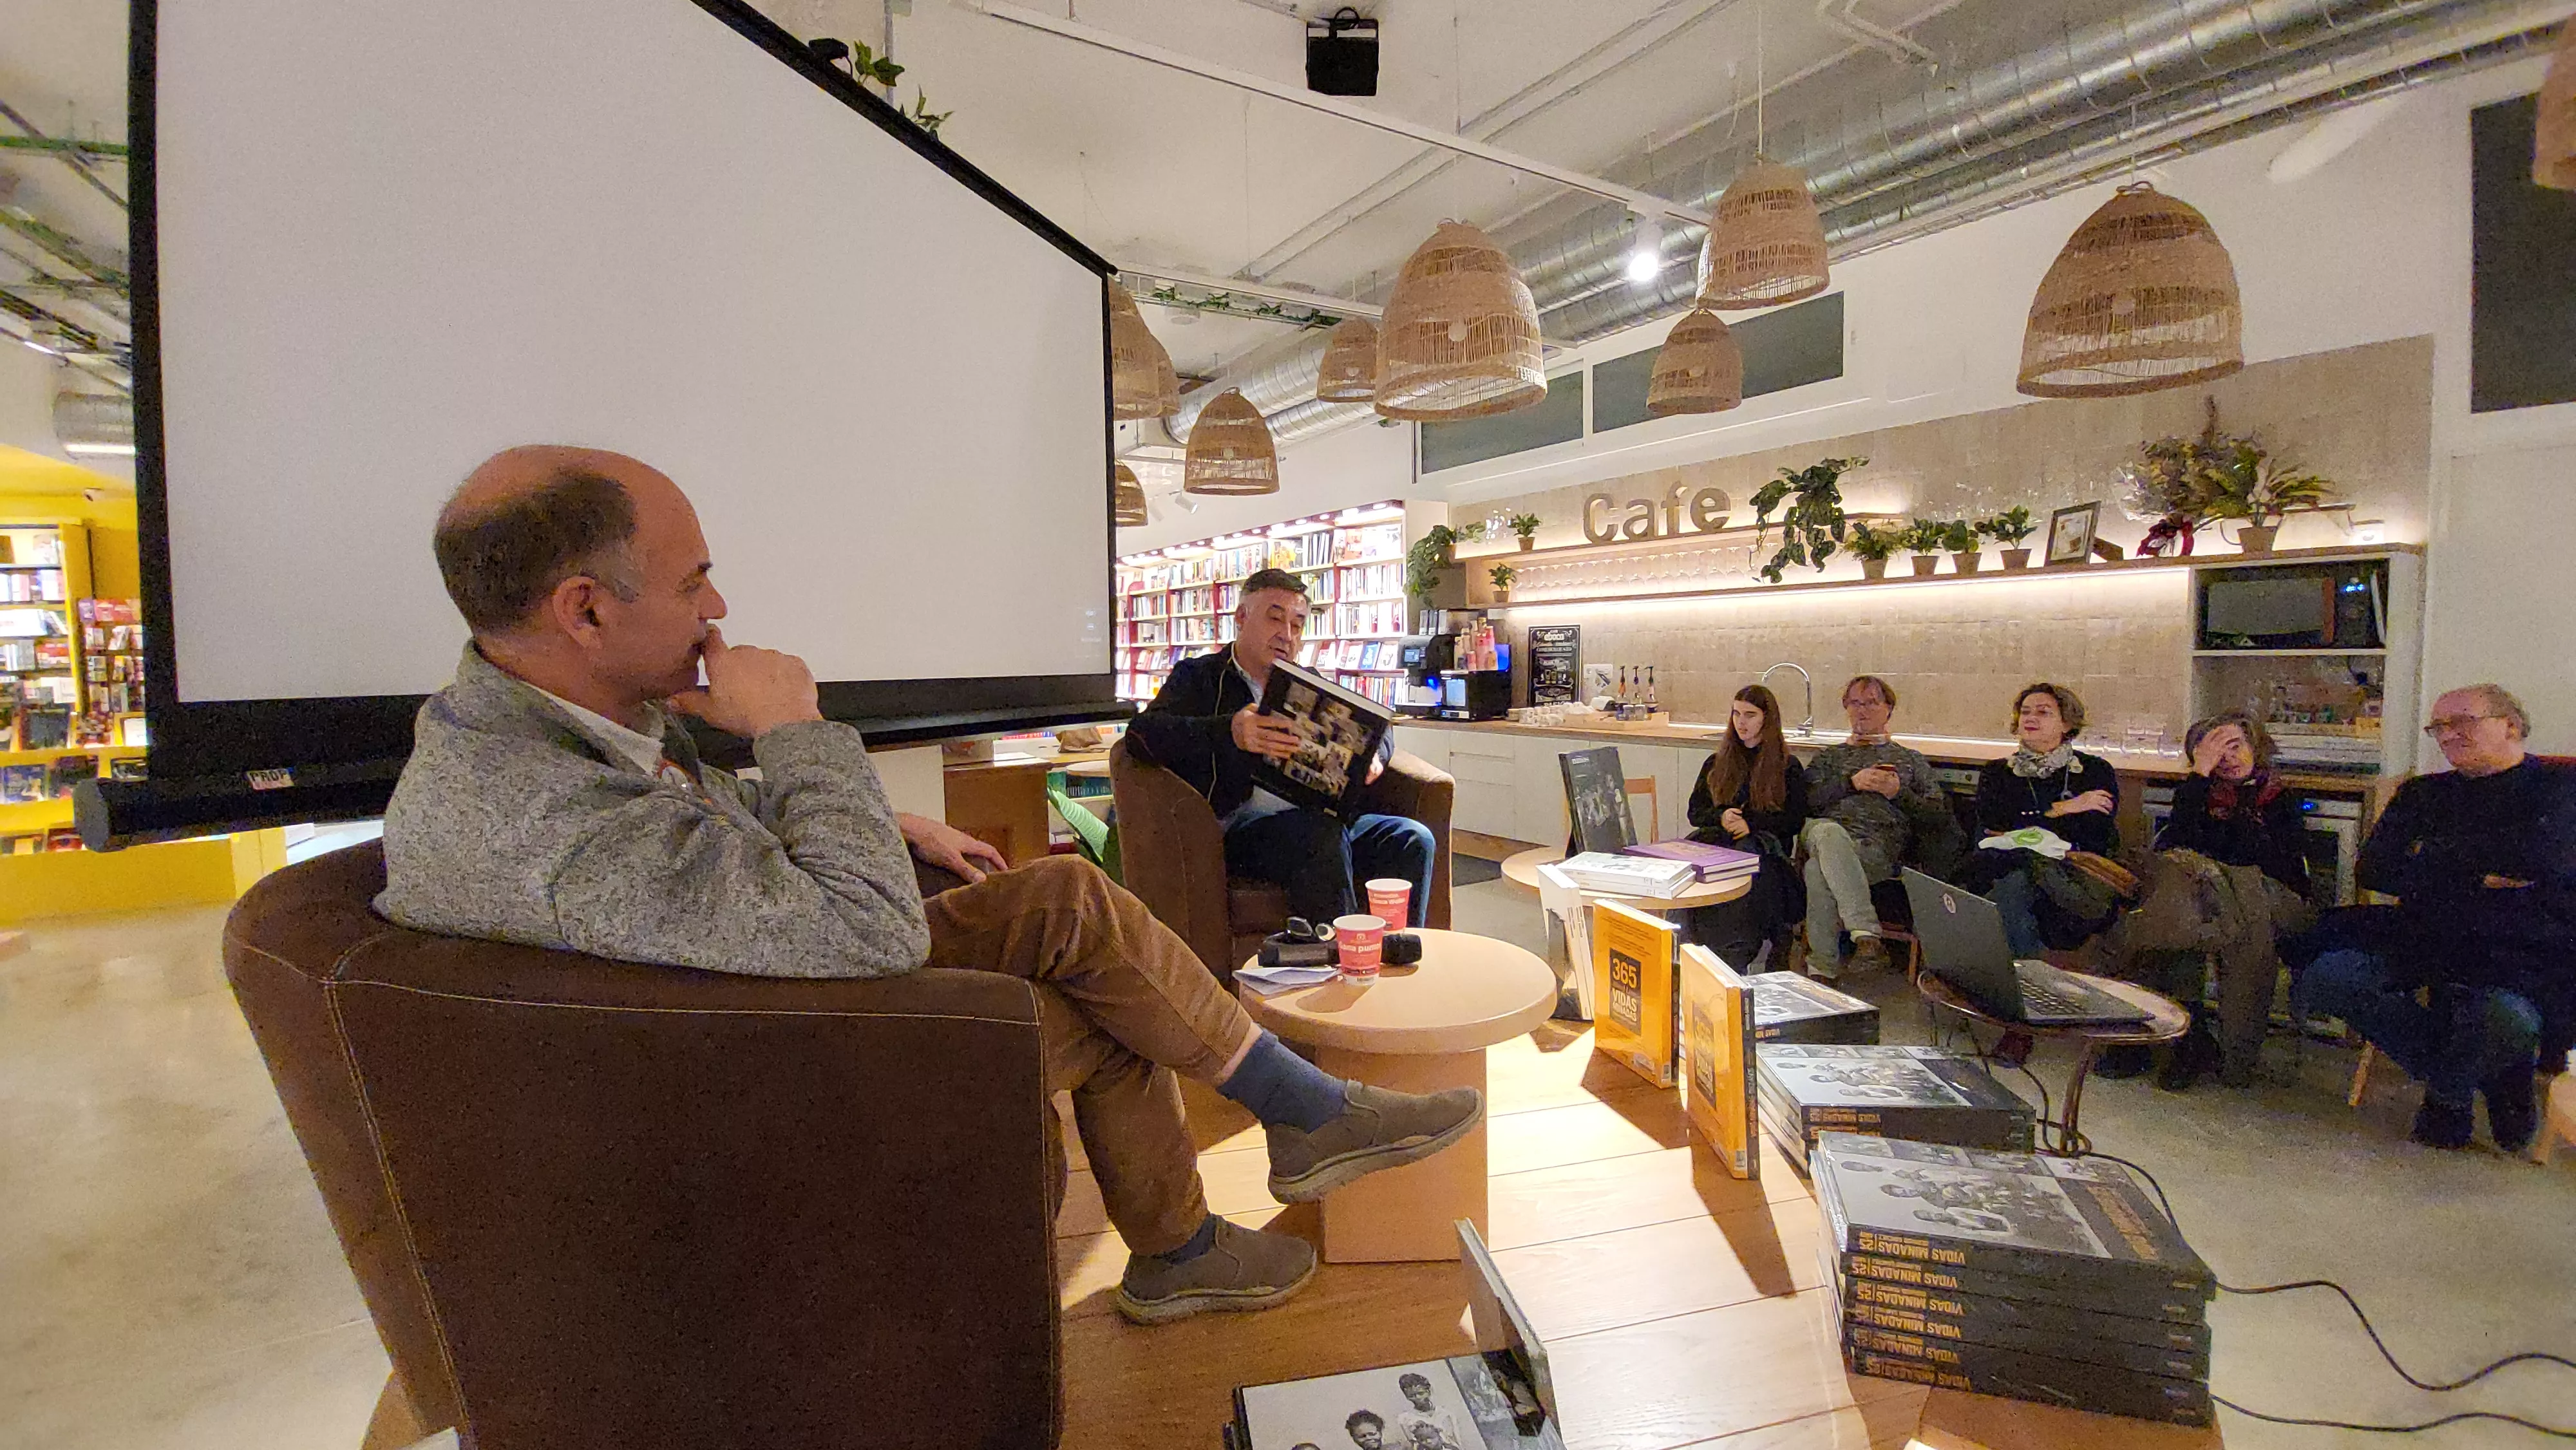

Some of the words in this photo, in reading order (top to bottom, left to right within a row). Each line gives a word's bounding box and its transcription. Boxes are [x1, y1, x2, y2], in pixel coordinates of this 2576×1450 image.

[1584, 482, 1731, 543] Cafe
[1613, 958, 1637, 988] 365
[1612, 988, 1637, 1012] VIDAS
[1860, 1238, 1873, 1250] 25
[1878, 1241, 1929, 1259] MINADAS
[1932, 1248, 1965, 1266] VIDAS
[1871, 1265, 1922, 1283] MINADAS
[1924, 1272, 1958, 1288] VIDAS
[1876, 1291, 1926, 1309] MINADAS
[1929, 1299, 1964, 1316] VIDAS
[1874, 1314, 1924, 1332] MINADAS
[1927, 1322, 1961, 1339] VIDAS
[1926, 1346, 1960, 1364] VIDAS
